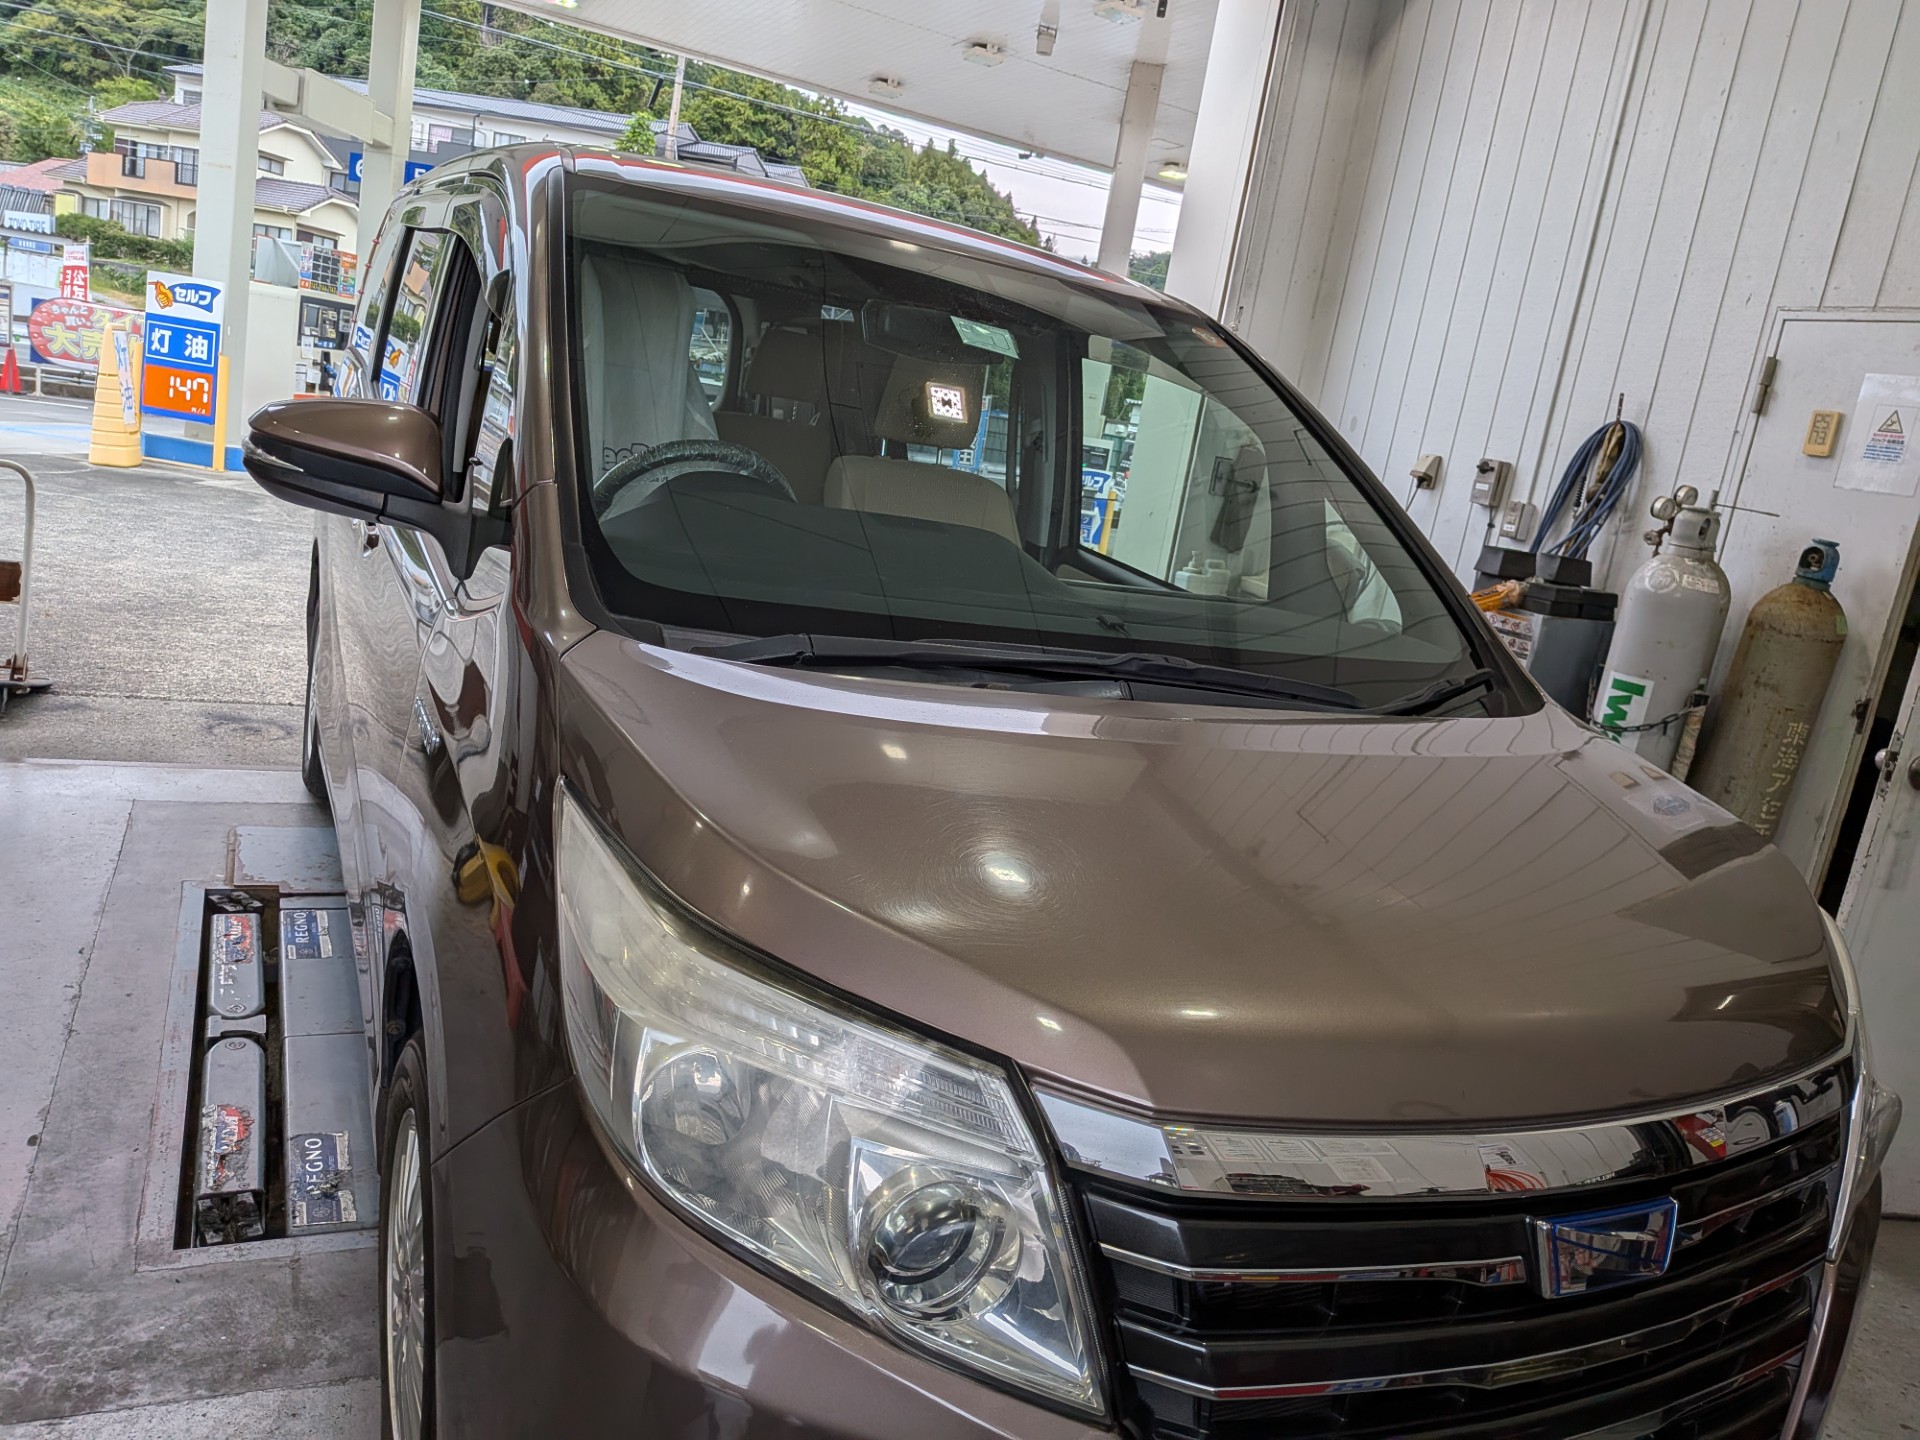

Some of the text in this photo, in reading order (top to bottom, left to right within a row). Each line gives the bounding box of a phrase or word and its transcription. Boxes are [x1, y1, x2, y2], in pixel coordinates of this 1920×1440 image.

[51, 305, 88, 314] ちゃんと
[174, 286, 211, 305] セルフ
[151, 328, 209, 361] 灯油
[169, 375, 209, 404] 147
[294, 912, 310, 943] REGNO
